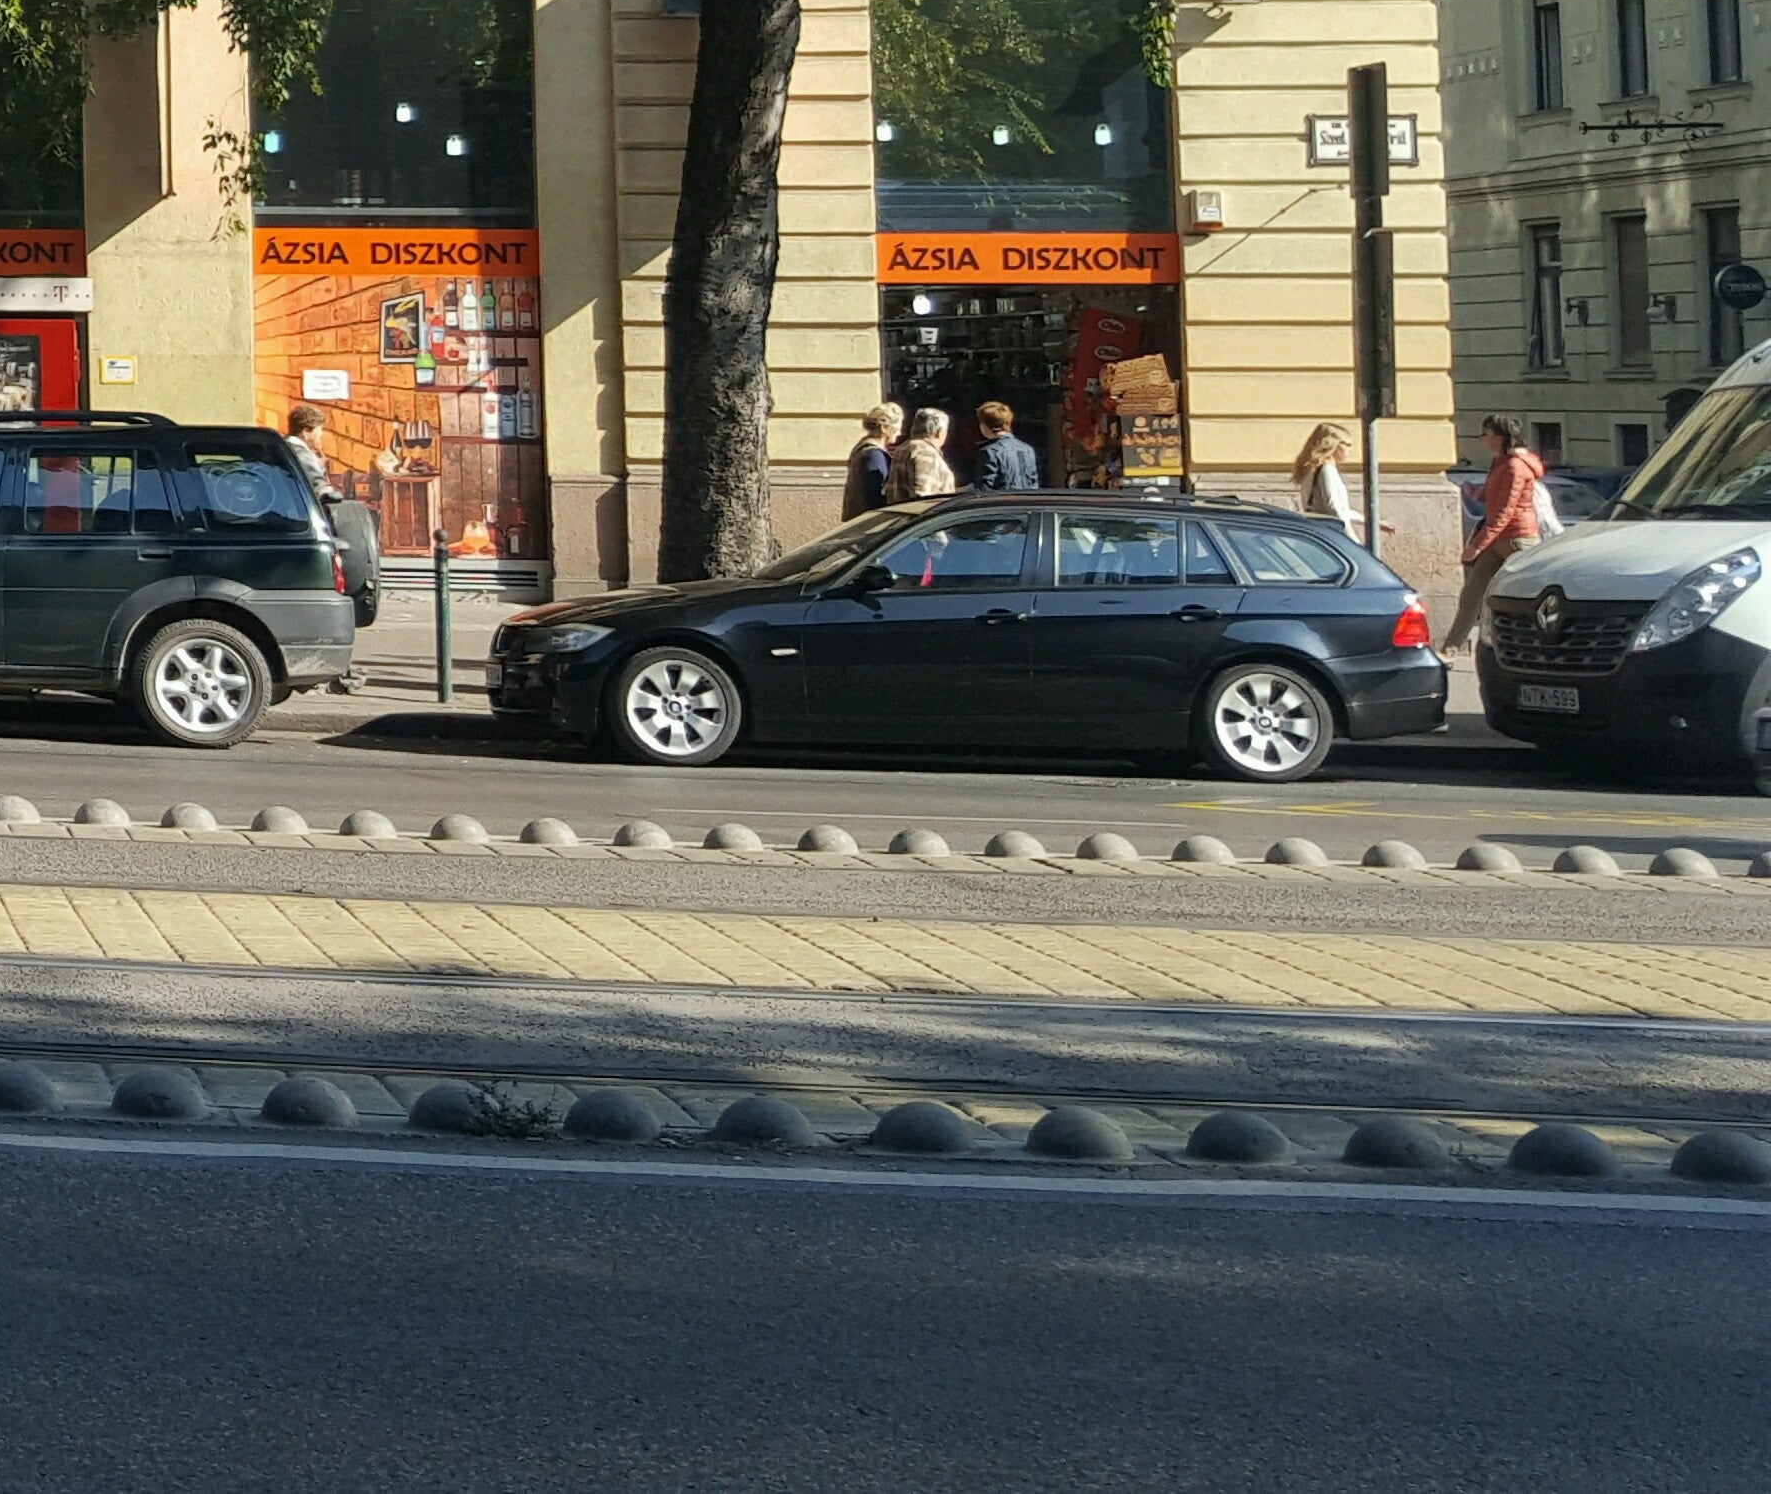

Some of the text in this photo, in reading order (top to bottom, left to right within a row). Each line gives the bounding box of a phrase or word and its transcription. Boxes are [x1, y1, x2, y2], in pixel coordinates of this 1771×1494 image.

[260, 236, 527, 265] ÁZSIA DISZKONT
[887, 242, 1165, 271] ÁZSIA DISZKONT
